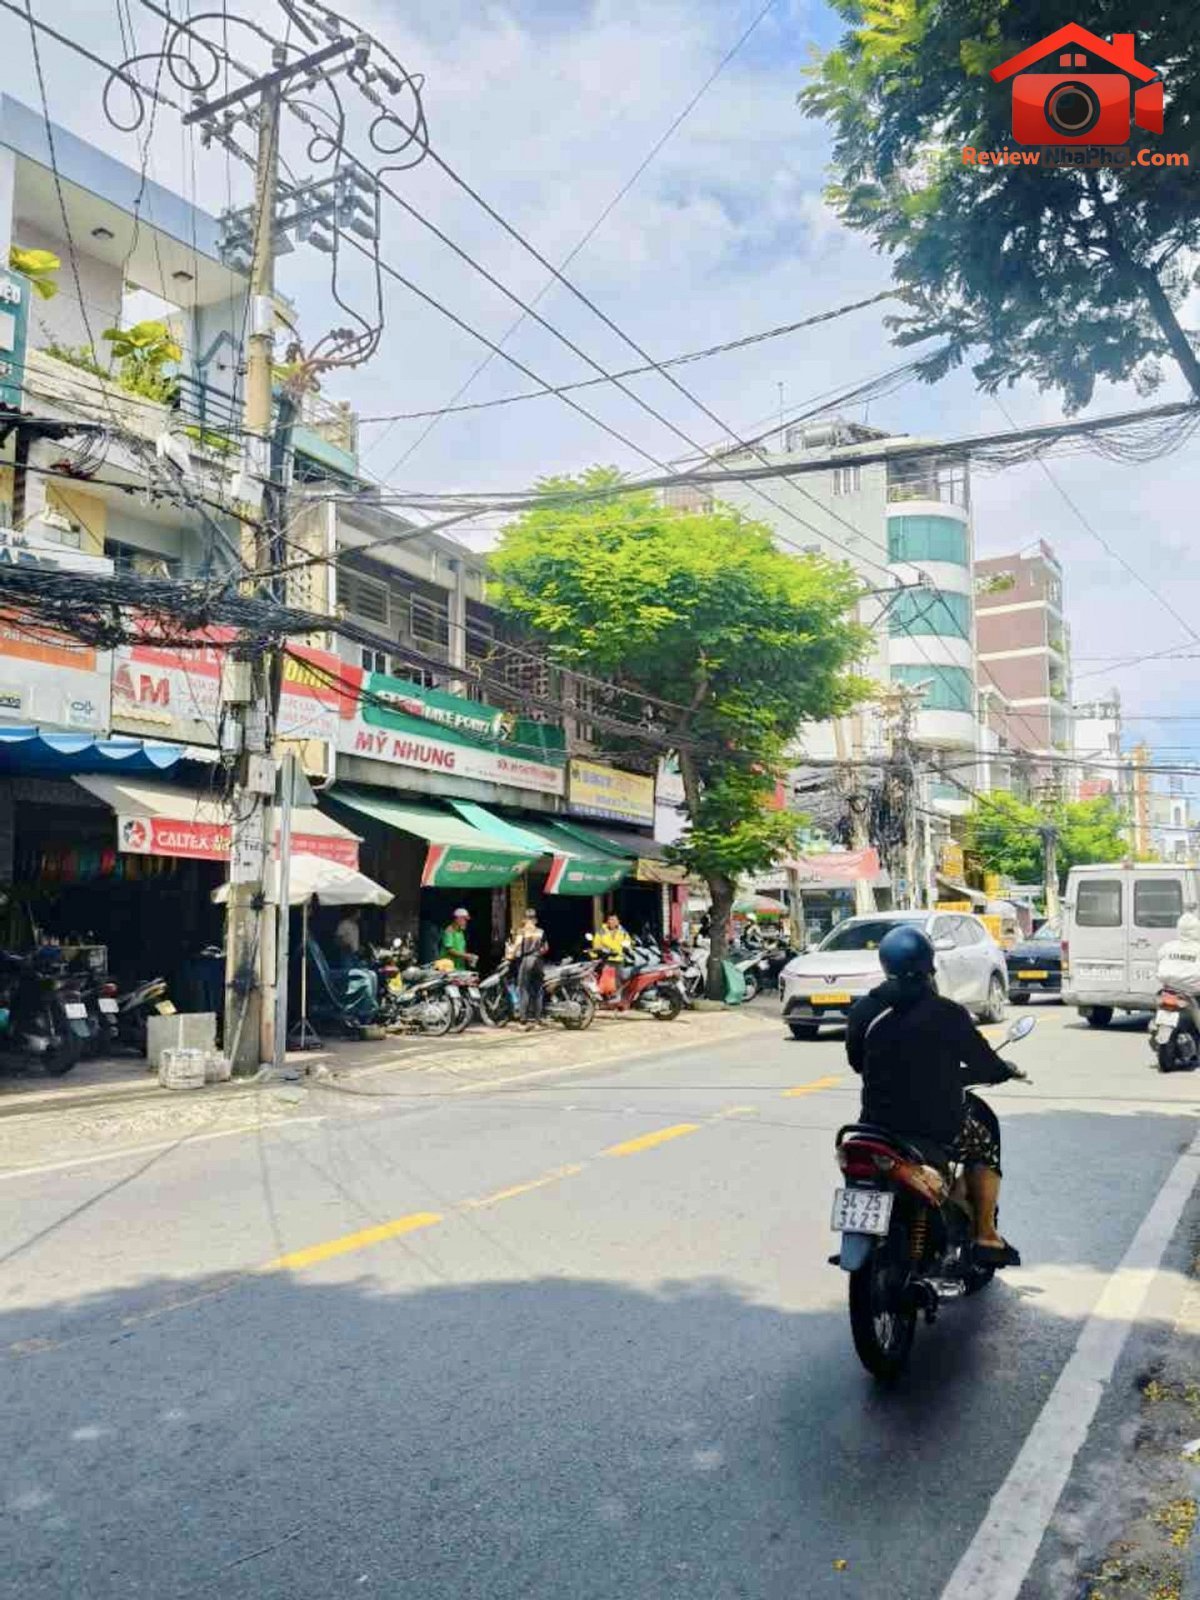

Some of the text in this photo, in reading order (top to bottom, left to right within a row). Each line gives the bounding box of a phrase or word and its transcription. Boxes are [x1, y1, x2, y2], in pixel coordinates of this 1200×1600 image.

[355, 731, 456, 768] MỸ NHUNG
[157, 831, 209, 850] CALTEX
